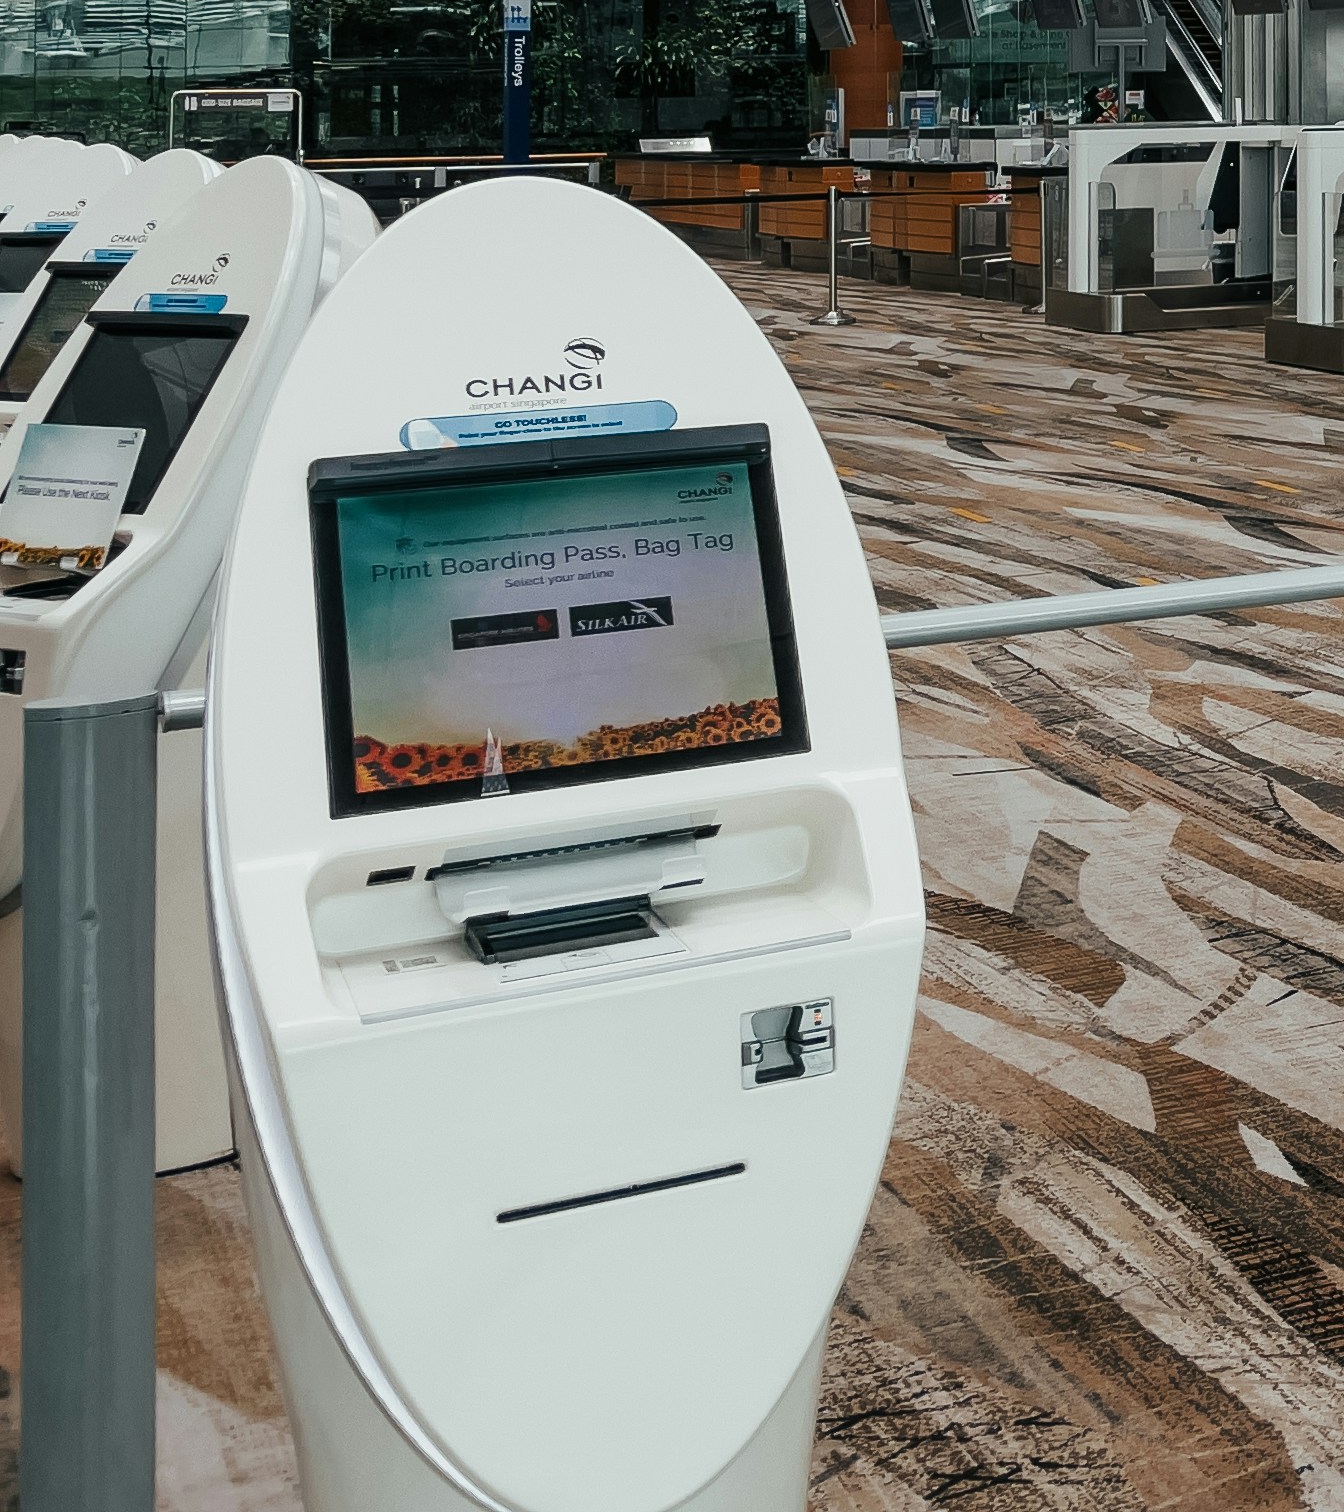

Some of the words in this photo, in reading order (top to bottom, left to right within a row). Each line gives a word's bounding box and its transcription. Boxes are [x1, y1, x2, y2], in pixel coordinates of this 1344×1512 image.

[512, 36, 525, 86] Trolleys
[110, 234, 149, 244] CHANGI
[170, 273, 219, 286] CHANGI
[465, 372, 603, 399] CHANGI
[468, 399, 507, 412] airport
[510, 397, 568, 411] singapore
[677, 486, 732, 500] CHANGI
[371, 561, 432, 582] Print
[440, 549, 556, 576] Boarding
[635, 537, 681, 557] Bag
[689, 531, 734, 551] Tag
[504, 576, 545, 589] Select
[547, 573, 575, 585] your
[577, 568, 615, 580] airline
